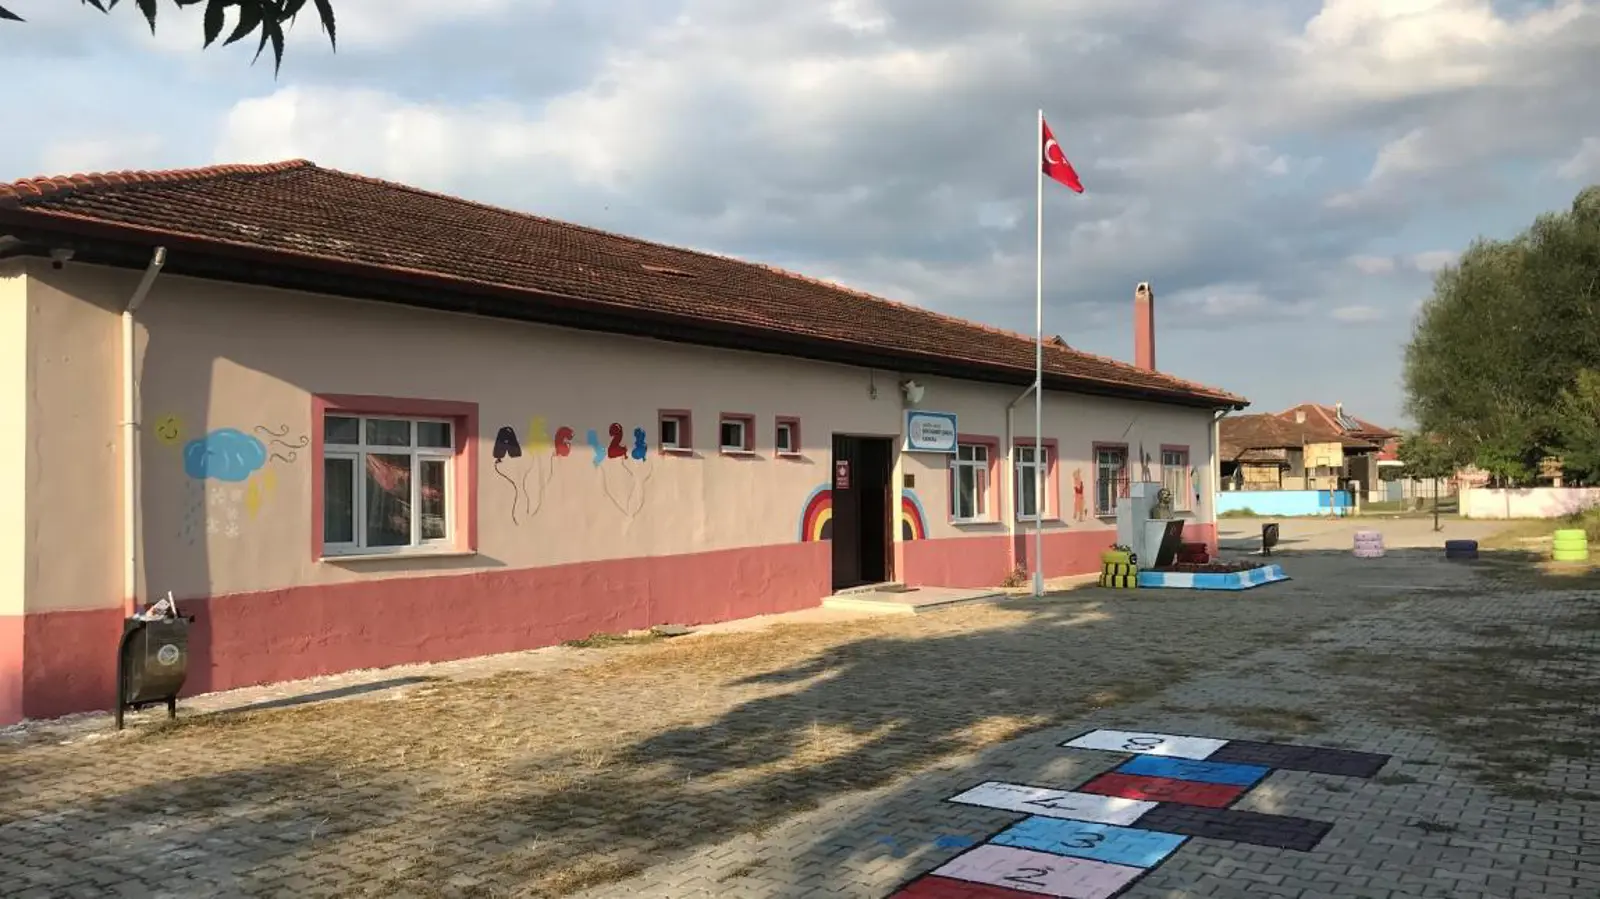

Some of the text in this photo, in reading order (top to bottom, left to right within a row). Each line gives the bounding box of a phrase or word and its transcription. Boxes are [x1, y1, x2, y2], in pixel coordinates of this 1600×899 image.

[1021, 796, 1077, 811] 4
[1060, 831, 1105, 848] 3
[1003, 866, 1053, 886] 2
